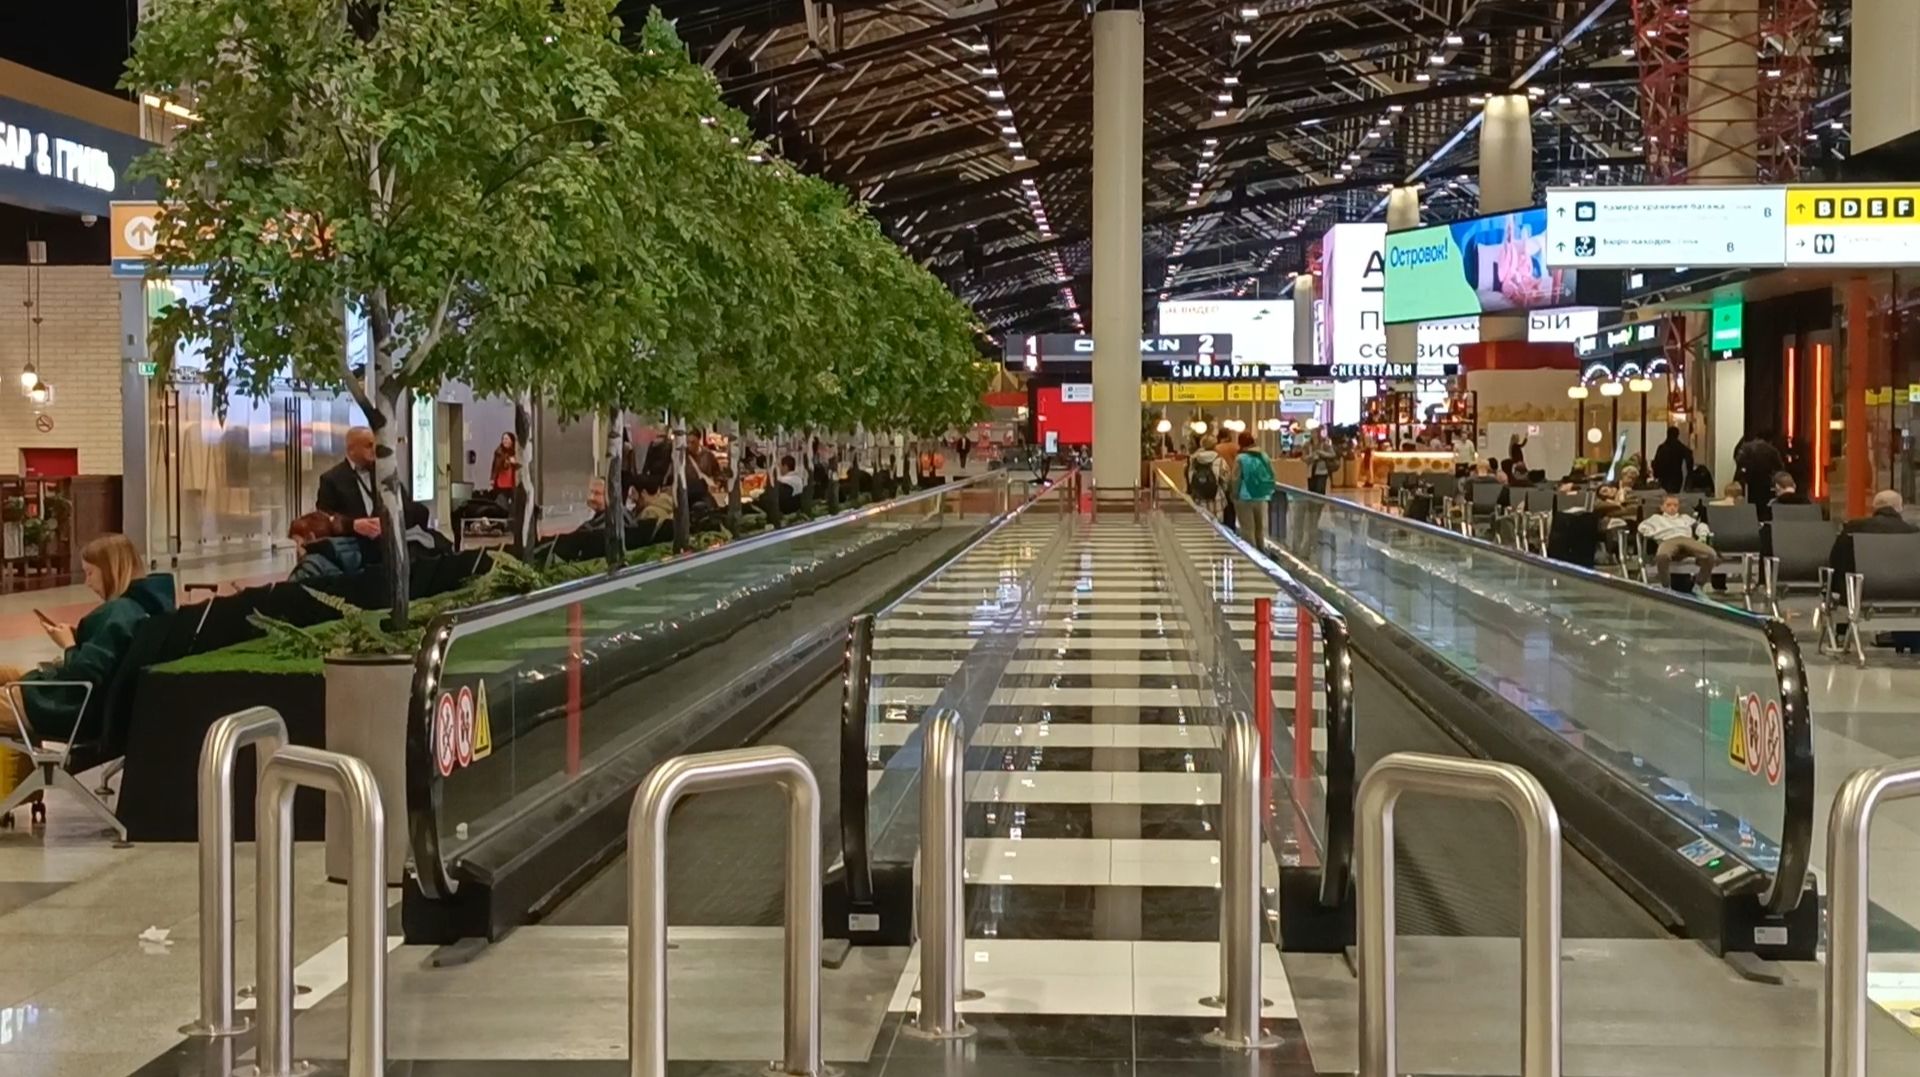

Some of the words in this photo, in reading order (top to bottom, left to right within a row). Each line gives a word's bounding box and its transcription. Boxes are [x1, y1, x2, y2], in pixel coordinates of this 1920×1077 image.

[36, 132, 52, 176] &
[1818, 200, 1832, 217] B
[1843, 200, 1859, 217] D
[1871, 199, 1884, 217] E
[1897, 199, 1911, 216] F
[1390, 238, 1448, 270] Островок!
[1198, 334, 1215, 354] 2
[1359, 343, 1460, 359] севис
[1172, 364, 1260, 377] СЫРОВАРНЯ
[1330, 364, 1413, 376] CHEESEFARM
